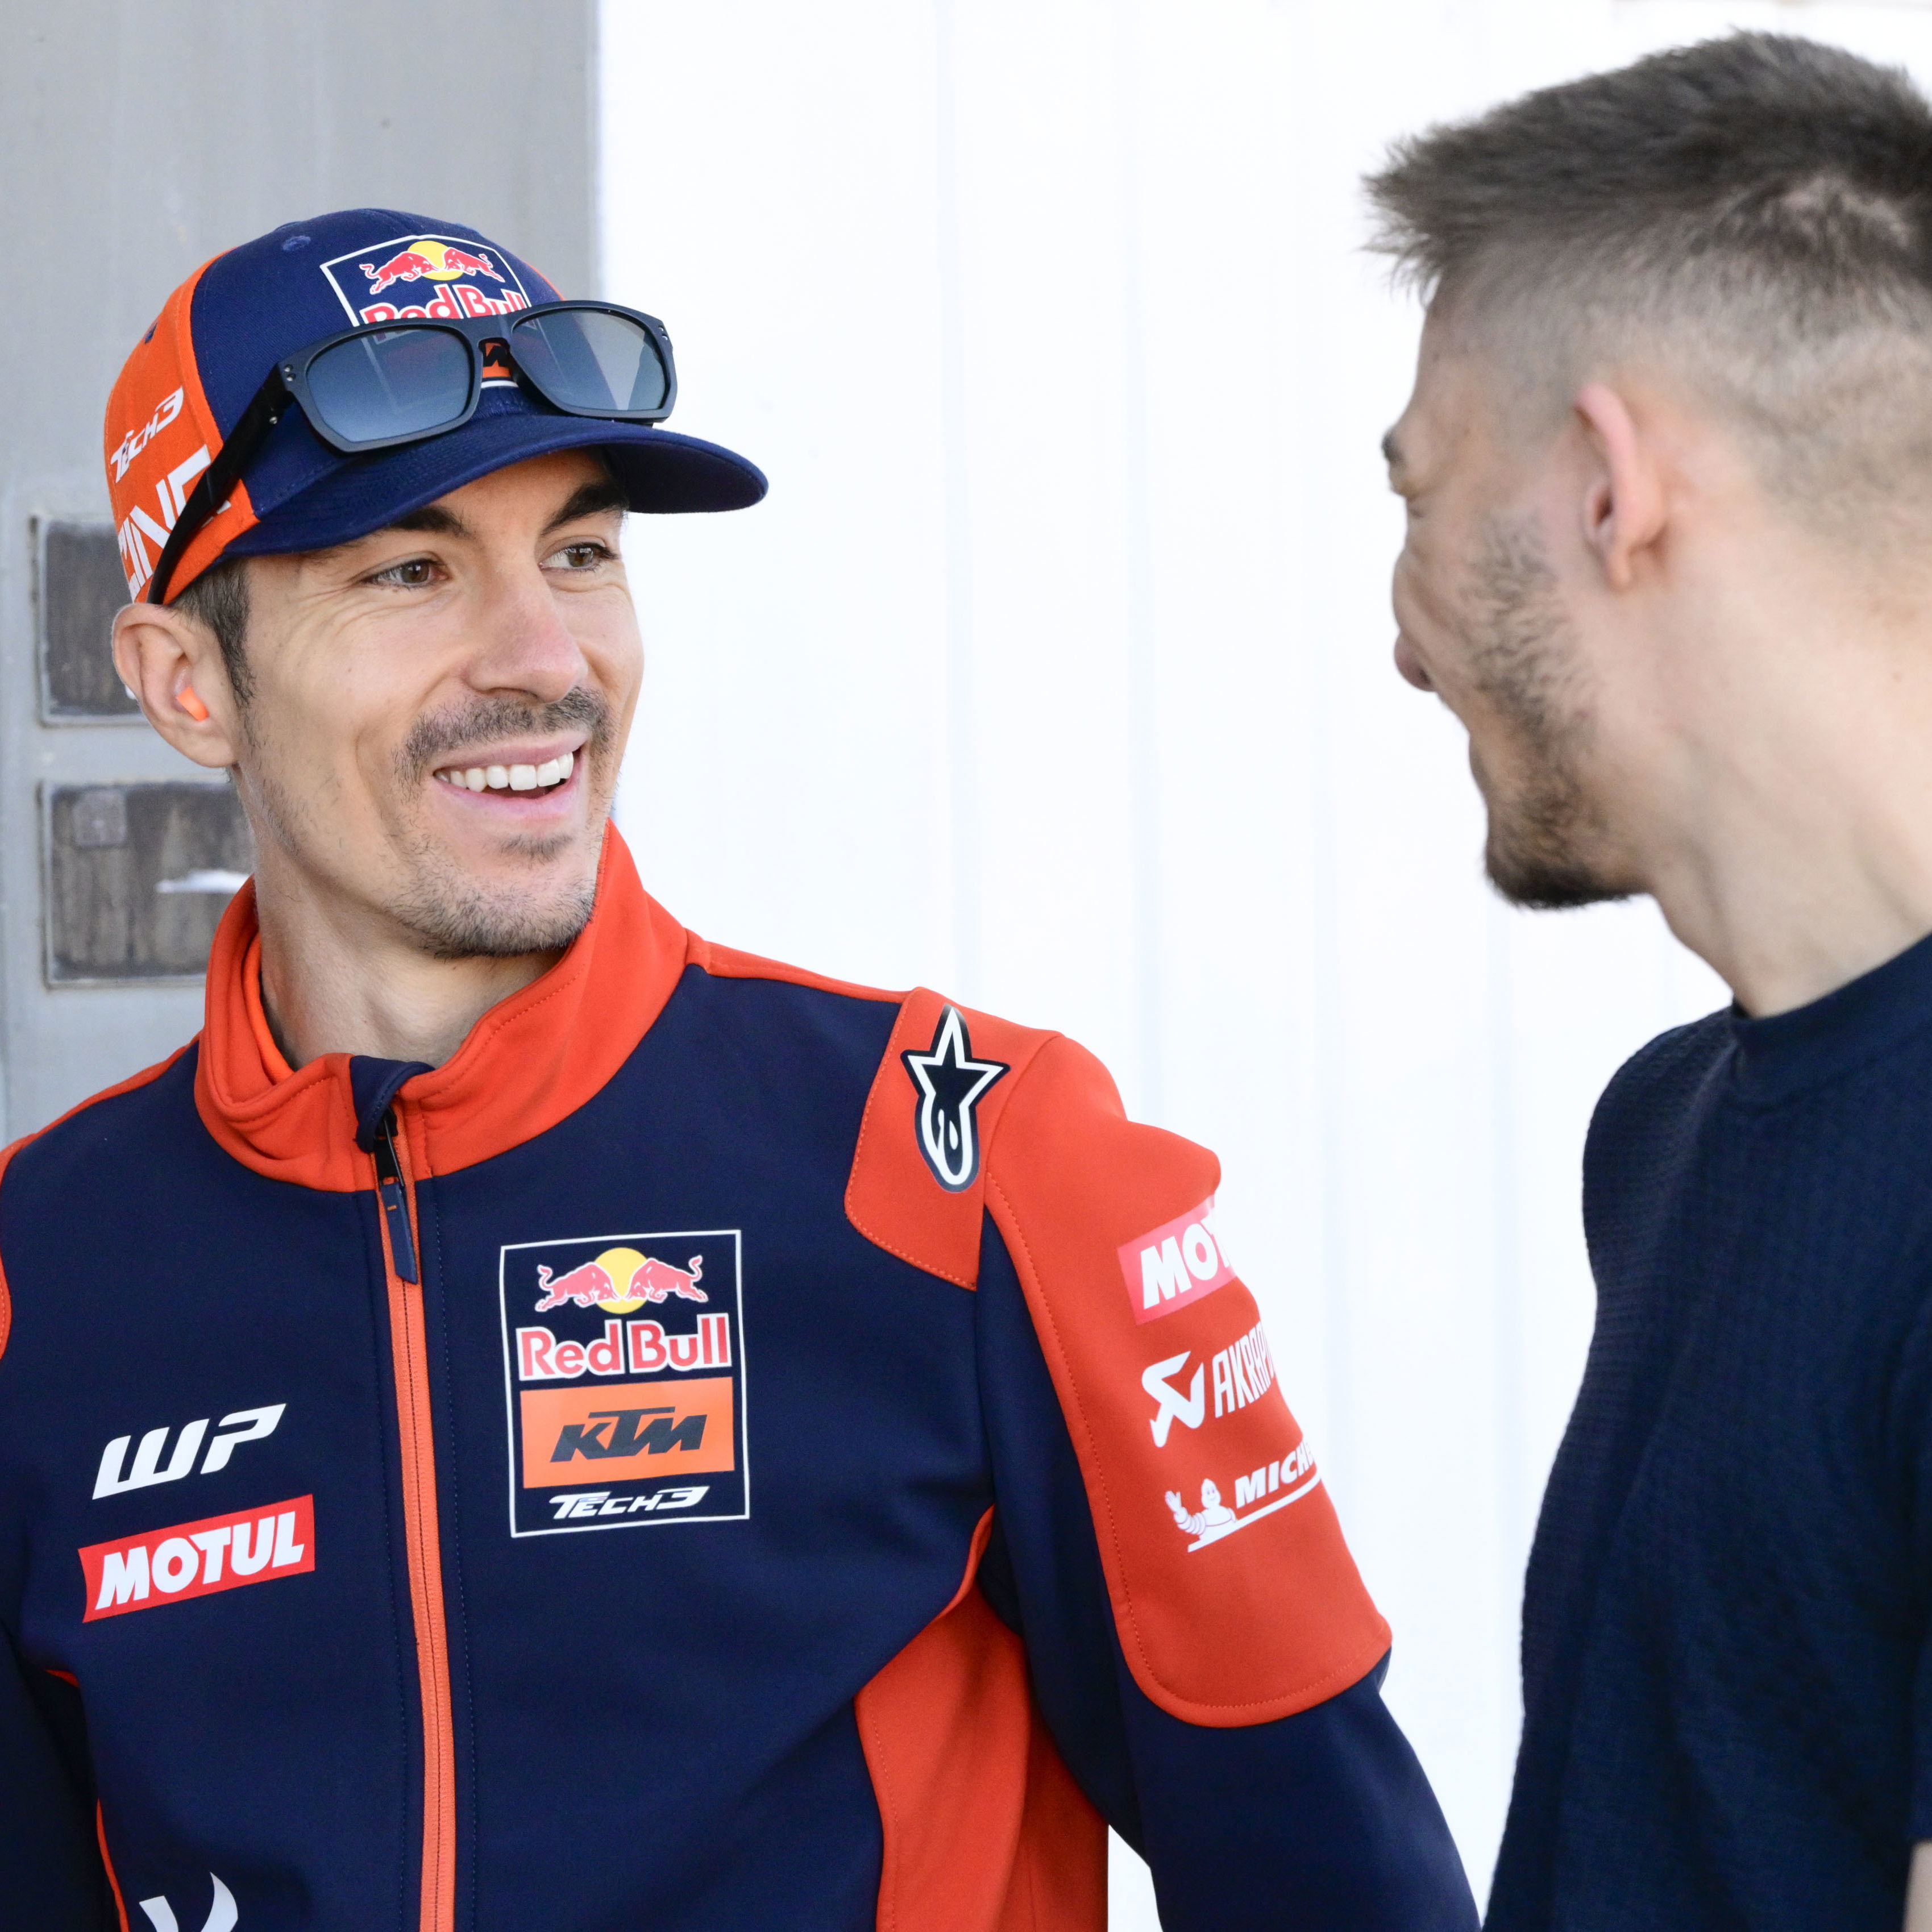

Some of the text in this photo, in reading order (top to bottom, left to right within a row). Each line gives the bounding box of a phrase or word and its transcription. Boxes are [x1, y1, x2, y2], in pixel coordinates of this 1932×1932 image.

[110, 386, 184, 483] TECH3
[517, 1314, 730, 1380] Red Bull
[92, 1403, 286, 1500] WP
[550, 1406, 707, 1462] KTM
[549, 1486, 710, 1519] TECH3
[95, 1511, 305, 1610] MOTUL
